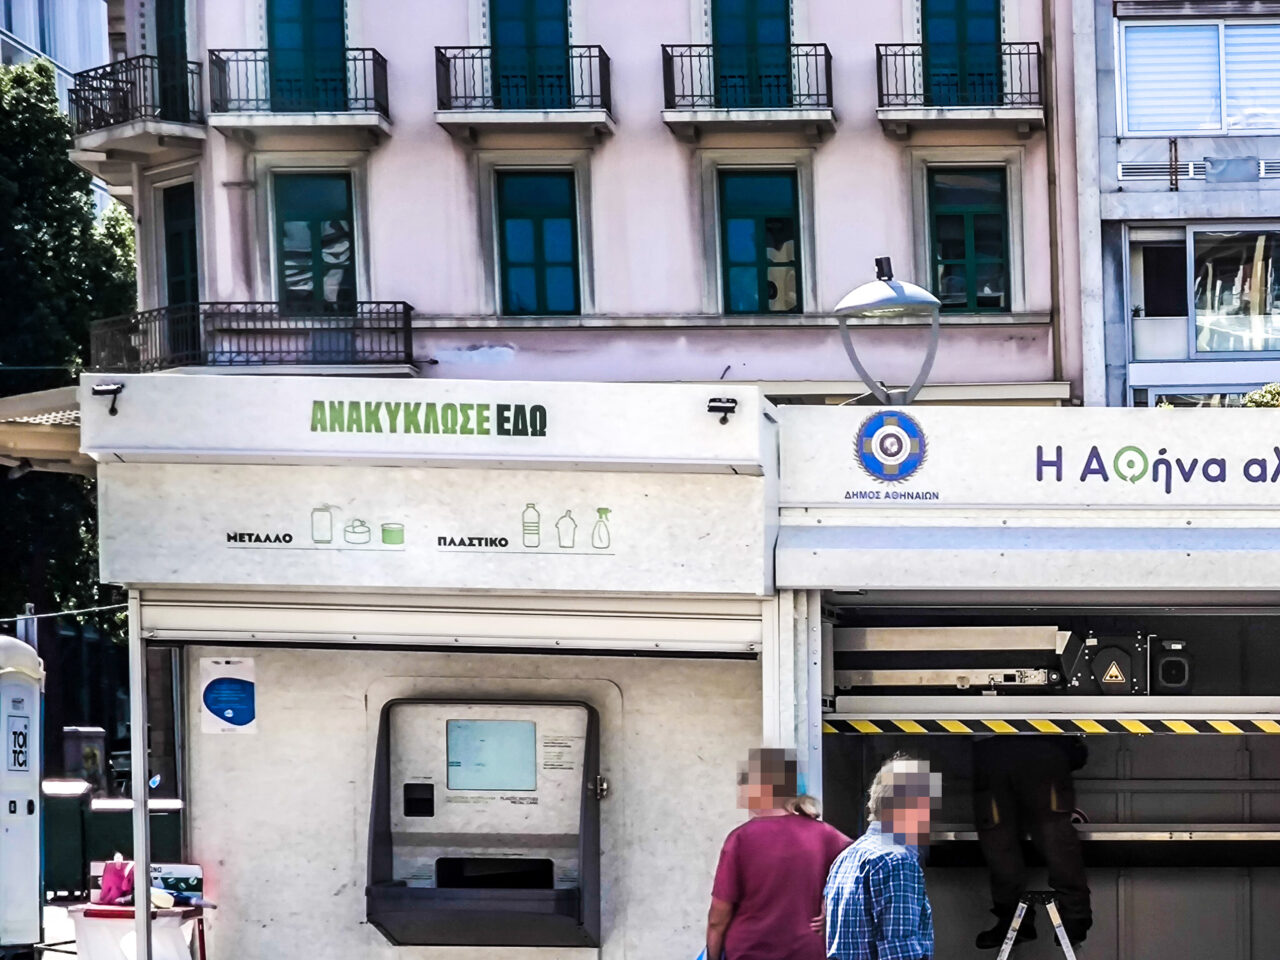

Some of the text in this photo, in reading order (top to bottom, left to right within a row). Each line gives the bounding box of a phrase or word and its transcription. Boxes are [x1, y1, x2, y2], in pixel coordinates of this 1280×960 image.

[310, 400, 547, 437] ΑΝΑΚΥΚΛΩΣΕ ΕΔΩ
[1036, 445, 1063, 482] Η
[844, 491, 940, 500] ΔΗΜΟΣ ΑΘΗΝΑΙΩΝ
[226, 532, 293, 544] ΜΕΤΑΛΛΟ
[437, 536, 509, 548] ΠΛΑΣΤΙΚΟ
